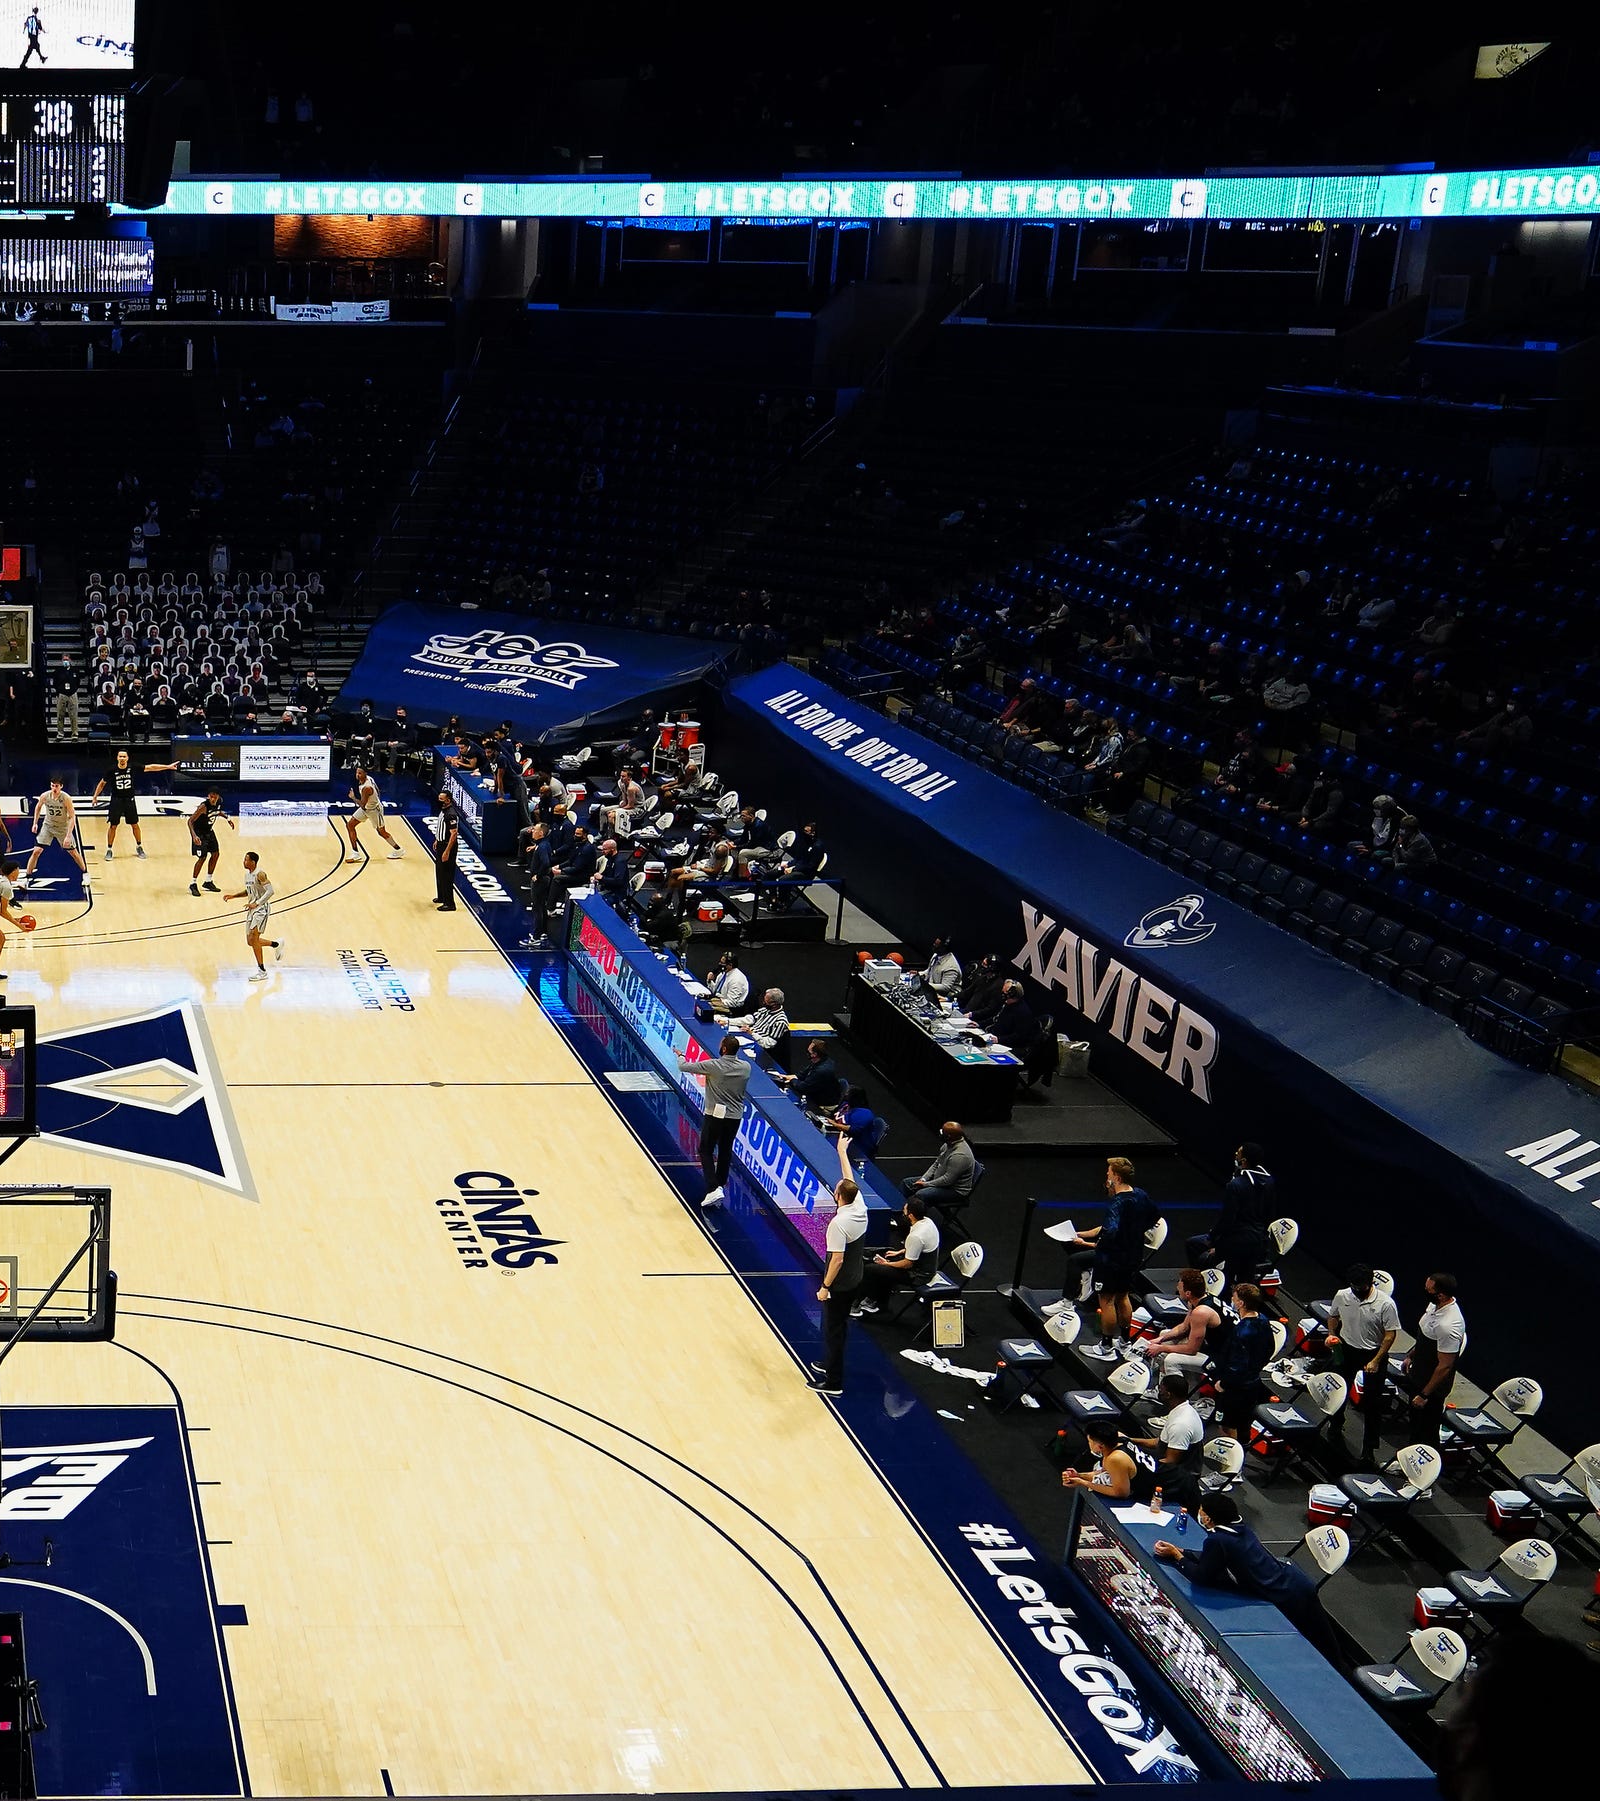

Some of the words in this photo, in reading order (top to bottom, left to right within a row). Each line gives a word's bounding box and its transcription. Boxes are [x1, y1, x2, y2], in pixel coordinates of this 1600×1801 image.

[34, 100, 74, 137] 38
[265, 187, 426, 210] #LETSGOX
[695, 186, 854, 212] #LETSGOX
[950, 183, 1135, 214] #LETSGOX
[403, 668, 452, 681] PRESENTED
[427, 651, 475, 667] XAVIER
[478, 662, 567, 683] BASKETBALL
[764, 689, 809, 715] ALL
[787, 702, 835, 731] FOR
[812, 717, 864, 751] ONE,
[844, 737, 899, 768] ONE
[872, 753, 929, 785] FOR
[901, 771, 958, 802] ALL
[116, 779, 132, 789] 52
[49, 809, 62, 818] 32
[336, 949, 367, 979] FAMILY
[352, 981, 383, 1011] COURT
[361, 949, 415, 1012] KOHLHEPP
[1011, 900, 1218, 1104] XAVIER
[744, 1152, 778, 1198] CLEANUP
[435, 1199, 489, 1269] CENTER
